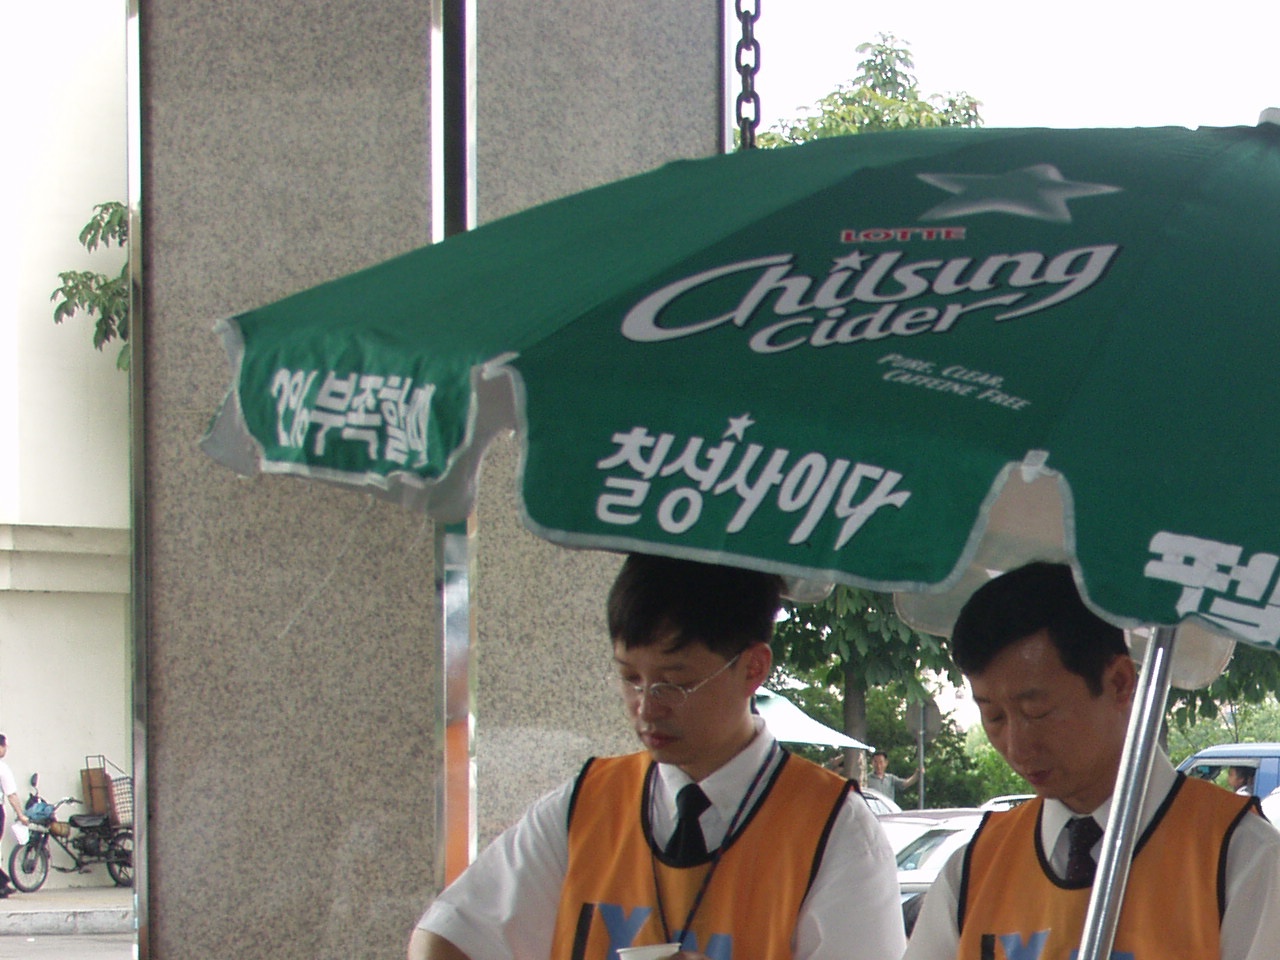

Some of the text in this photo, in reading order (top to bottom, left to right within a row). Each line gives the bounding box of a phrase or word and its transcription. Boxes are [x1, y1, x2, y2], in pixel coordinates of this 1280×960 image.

[840, 228, 966, 243] LOTTE
[621, 244, 1119, 342] Chilsung
[595, 426, 912, 551] 칠성사이다
